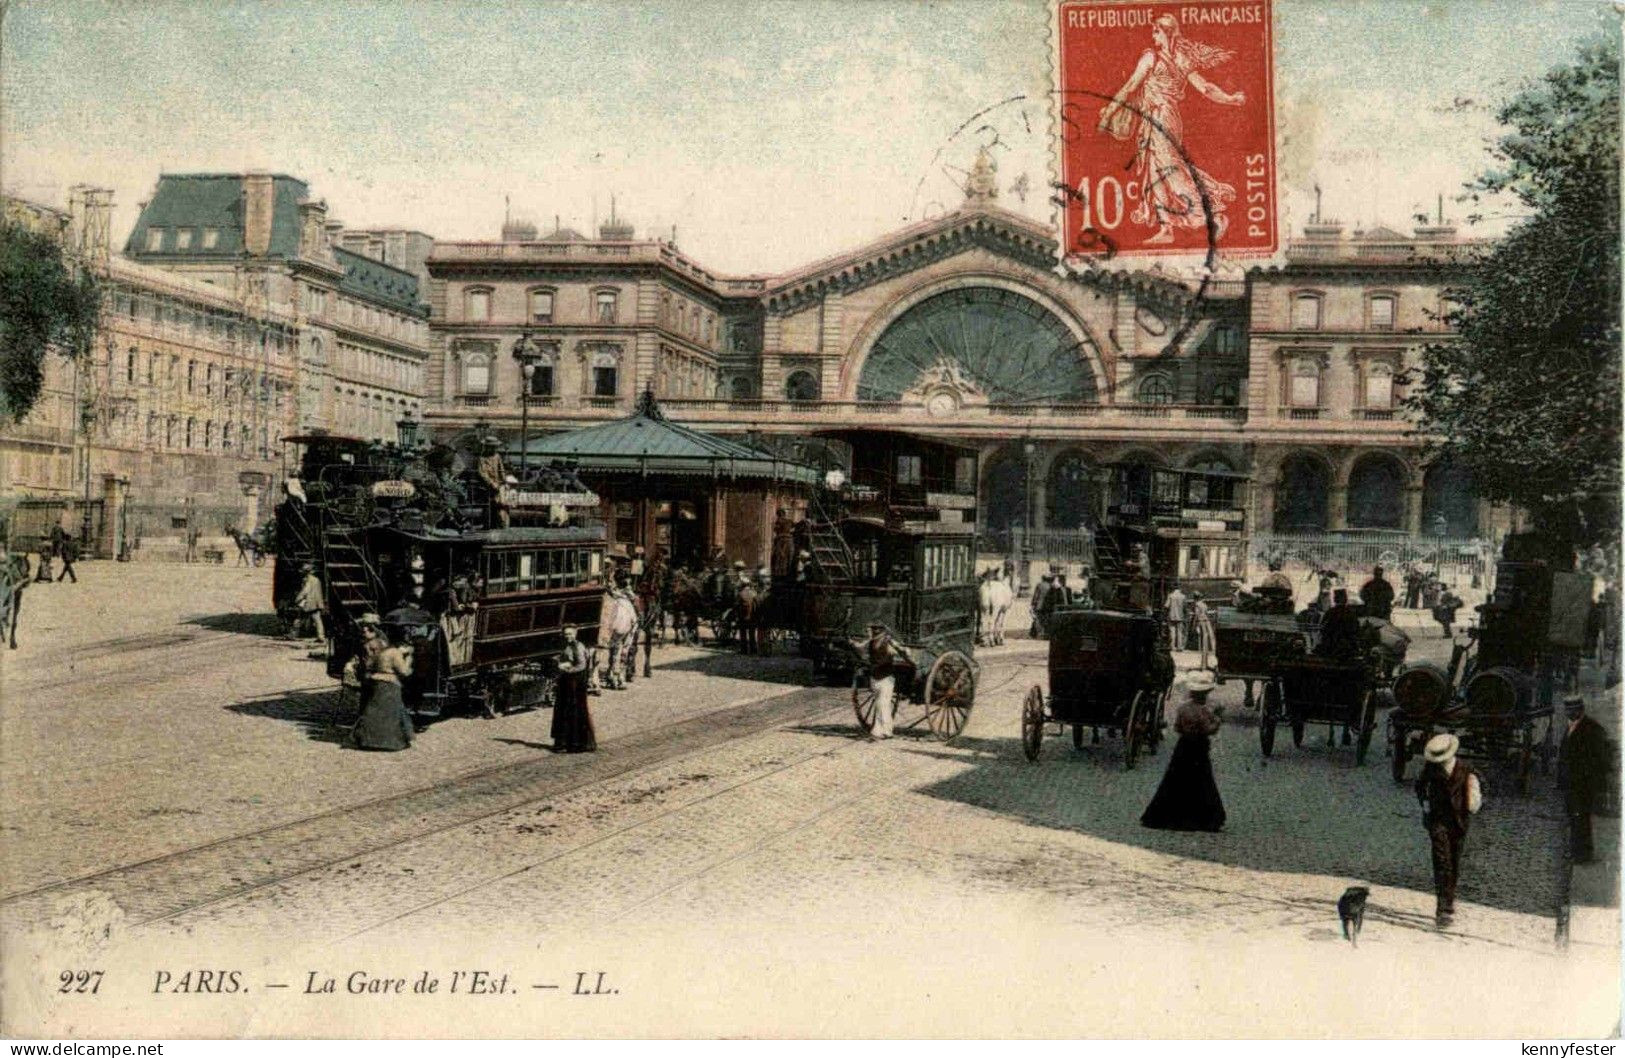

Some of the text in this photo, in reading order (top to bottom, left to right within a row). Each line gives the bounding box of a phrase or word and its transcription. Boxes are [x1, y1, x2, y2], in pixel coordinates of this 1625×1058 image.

[1068, 7, 1262, 28] REPUBLIQUE FRANÇAISE
[1245, 153, 1267, 238] POSTES
[59, 971, 104, 993] 227
[155, 971, 248, 993] PARIS.
[305, 971, 336, 993] La
[348, 971, 405, 993] Gare
[414, 971, 438, 993] de
[451, 971, 516, 993] l'Est.
[576, 972, 619, 994] LL.
